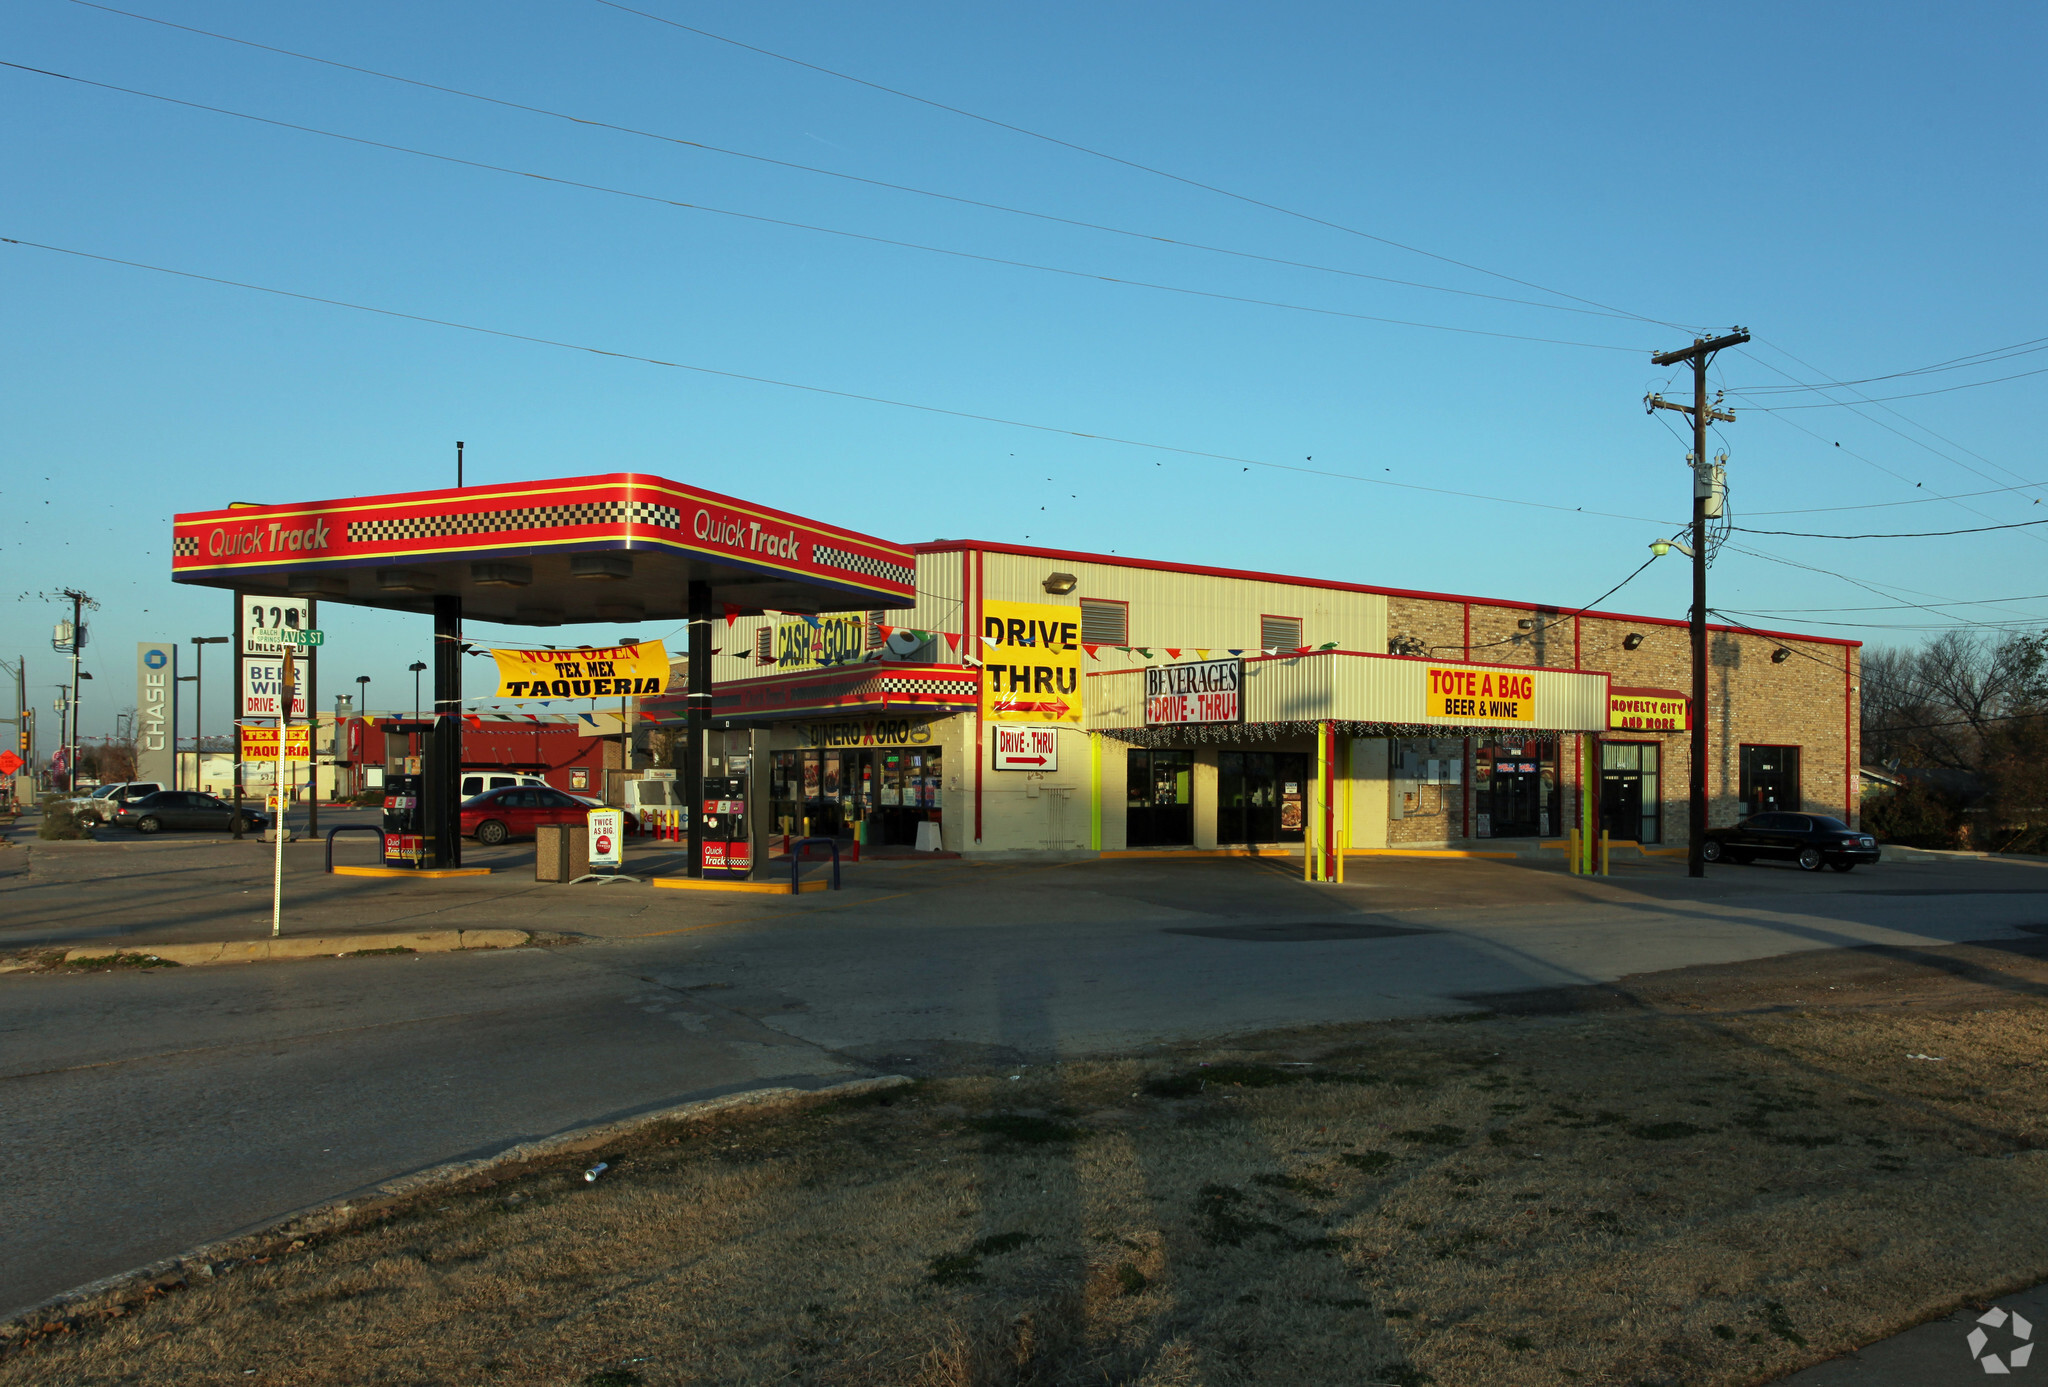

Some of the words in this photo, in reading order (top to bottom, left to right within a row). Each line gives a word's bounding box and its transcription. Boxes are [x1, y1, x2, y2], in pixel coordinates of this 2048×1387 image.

[208, 525, 264, 557] Quick
[267, 518, 330, 553] Track
[694, 509, 746, 548] Quick
[749, 521, 800, 561] Track
[283, 631, 306, 643] AVIS
[310, 632, 321, 644] ST
[779, 622, 810, 667] CASH
[811, 627, 823, 664] 4
[823, 615, 862, 661] GOLD
[985, 617, 1078, 651] DRIVE
[520, 649, 572, 664] NOW
[581, 644, 640, 662] OPEN
[554, 662, 582, 679] TEX
[586, 661, 616, 678] MEX
[985, 664, 1077, 695] THRU
[1148, 662, 1237, 696] BEVERAGES
[251, 681, 302, 696] WIE
[506, 677, 660, 698] TAQUERIA
[1430, 669, 1476, 696] TOTE
[1481, 674, 1493, 697] A
[1499, 675, 1532, 700] BAG
[146, 673, 165, 751] CHASE
[248, 697, 274, 712] DRIVE
[1154, 695, 1188, 723] DRIVE
[1197, 693, 1230, 721] THRU
[1445, 698, 1475, 716] BEER
[1479, 700, 1487, 716] &
[1489, 701, 1518, 718] WINE
[1611, 699, 1658, 714] NOVELTY
[1660, 702, 1684, 715] CITY
[811, 721, 860, 747] DINERO
[864, 720, 874, 746] X
[876, 719, 909, 744] ORO
[1621, 716, 1643, 729] AND
[1646, 717, 1676, 730] MORE
[245, 731, 274, 740] TEX
[1000, 731, 1025, 753] DRIVE
[1031, 731, 1054, 754] THRU
[593, 827, 602, 835] AS
[594, 818, 613, 826] TWICE
[704, 845, 723, 855] Quick
[704, 856, 726, 866] Track
